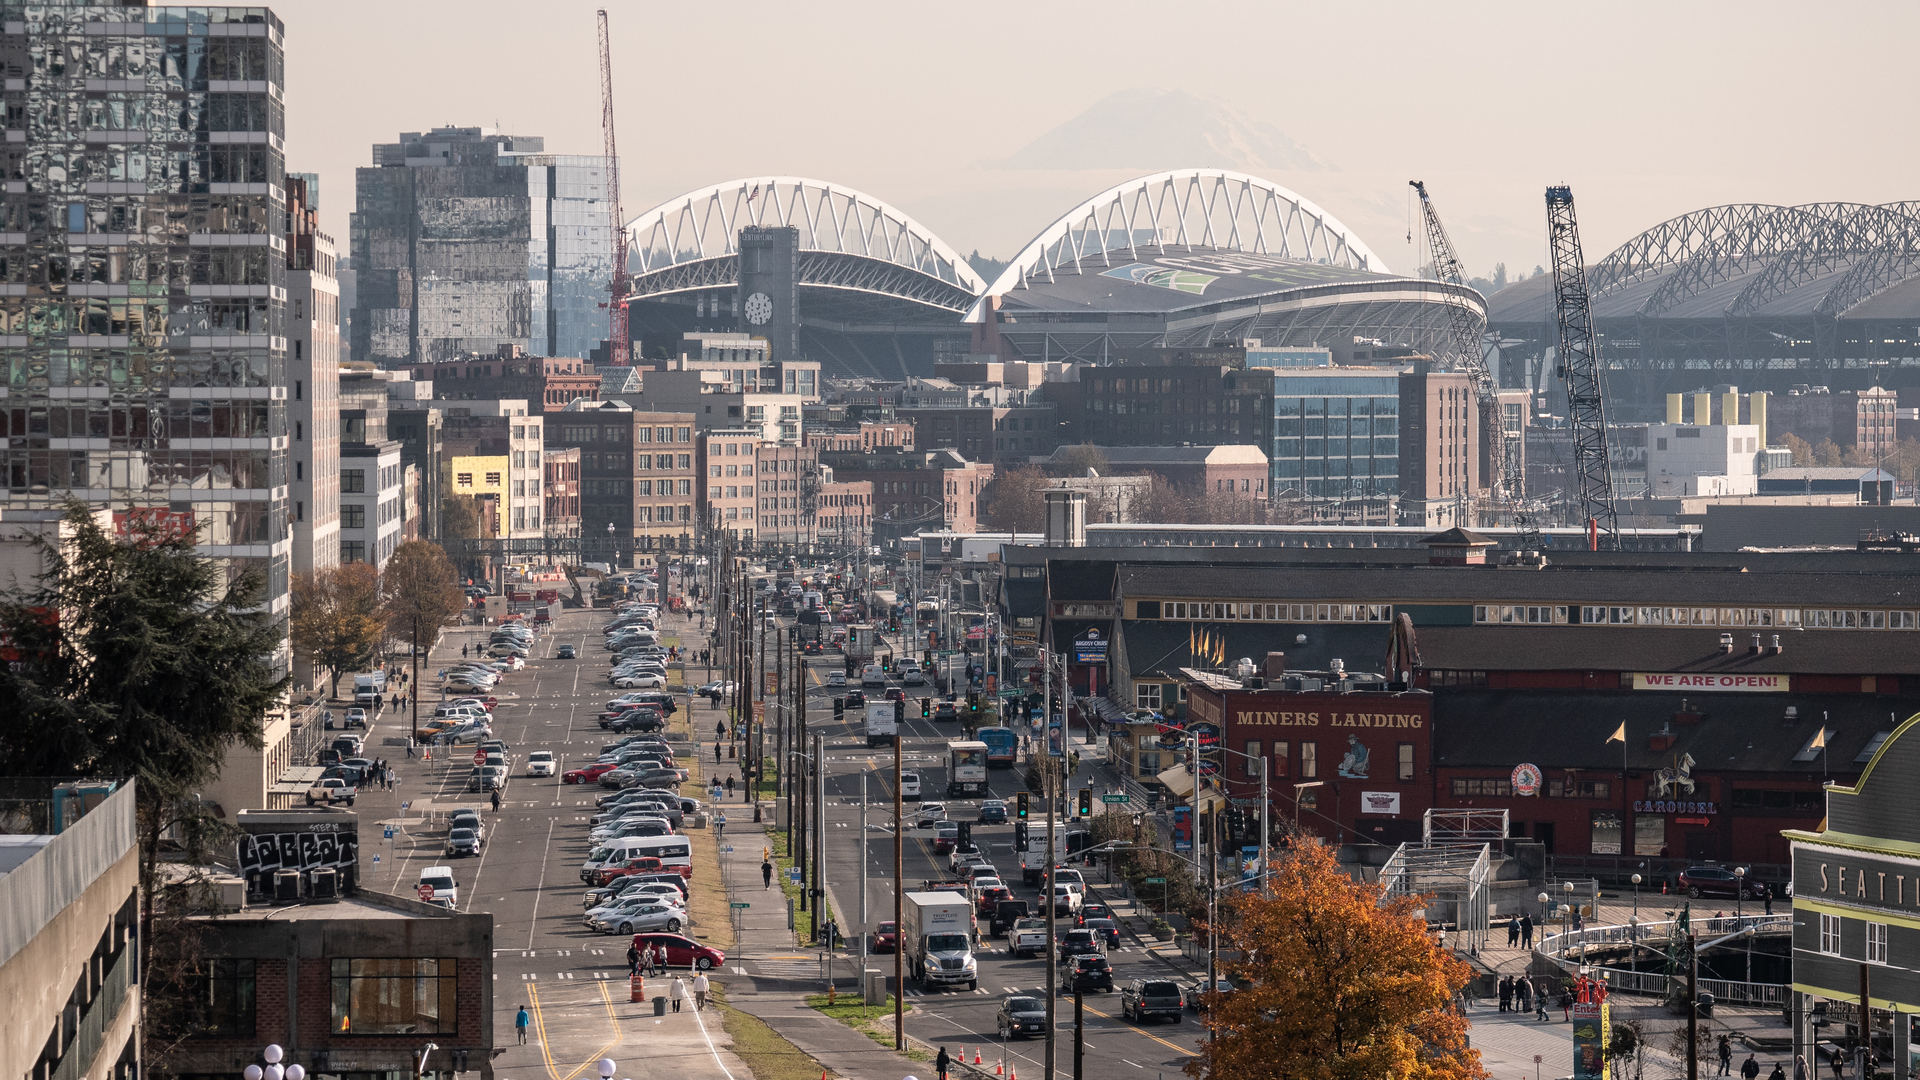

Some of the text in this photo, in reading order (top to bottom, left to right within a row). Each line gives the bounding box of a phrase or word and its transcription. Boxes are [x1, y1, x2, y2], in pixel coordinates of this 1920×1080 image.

[1433, 548, 1451, 556] PIER
[1645, 675, 1778, 687] WE ARE OPEN!
[1236, 711, 1423, 728] MINERS LANDING
[1633, 800, 1717, 814] CAROUSEL
[309, 823, 331, 832] STEP
[1820, 863, 1920, 907] SEATTL
[1574, 1004, 1600, 1014] Enter
